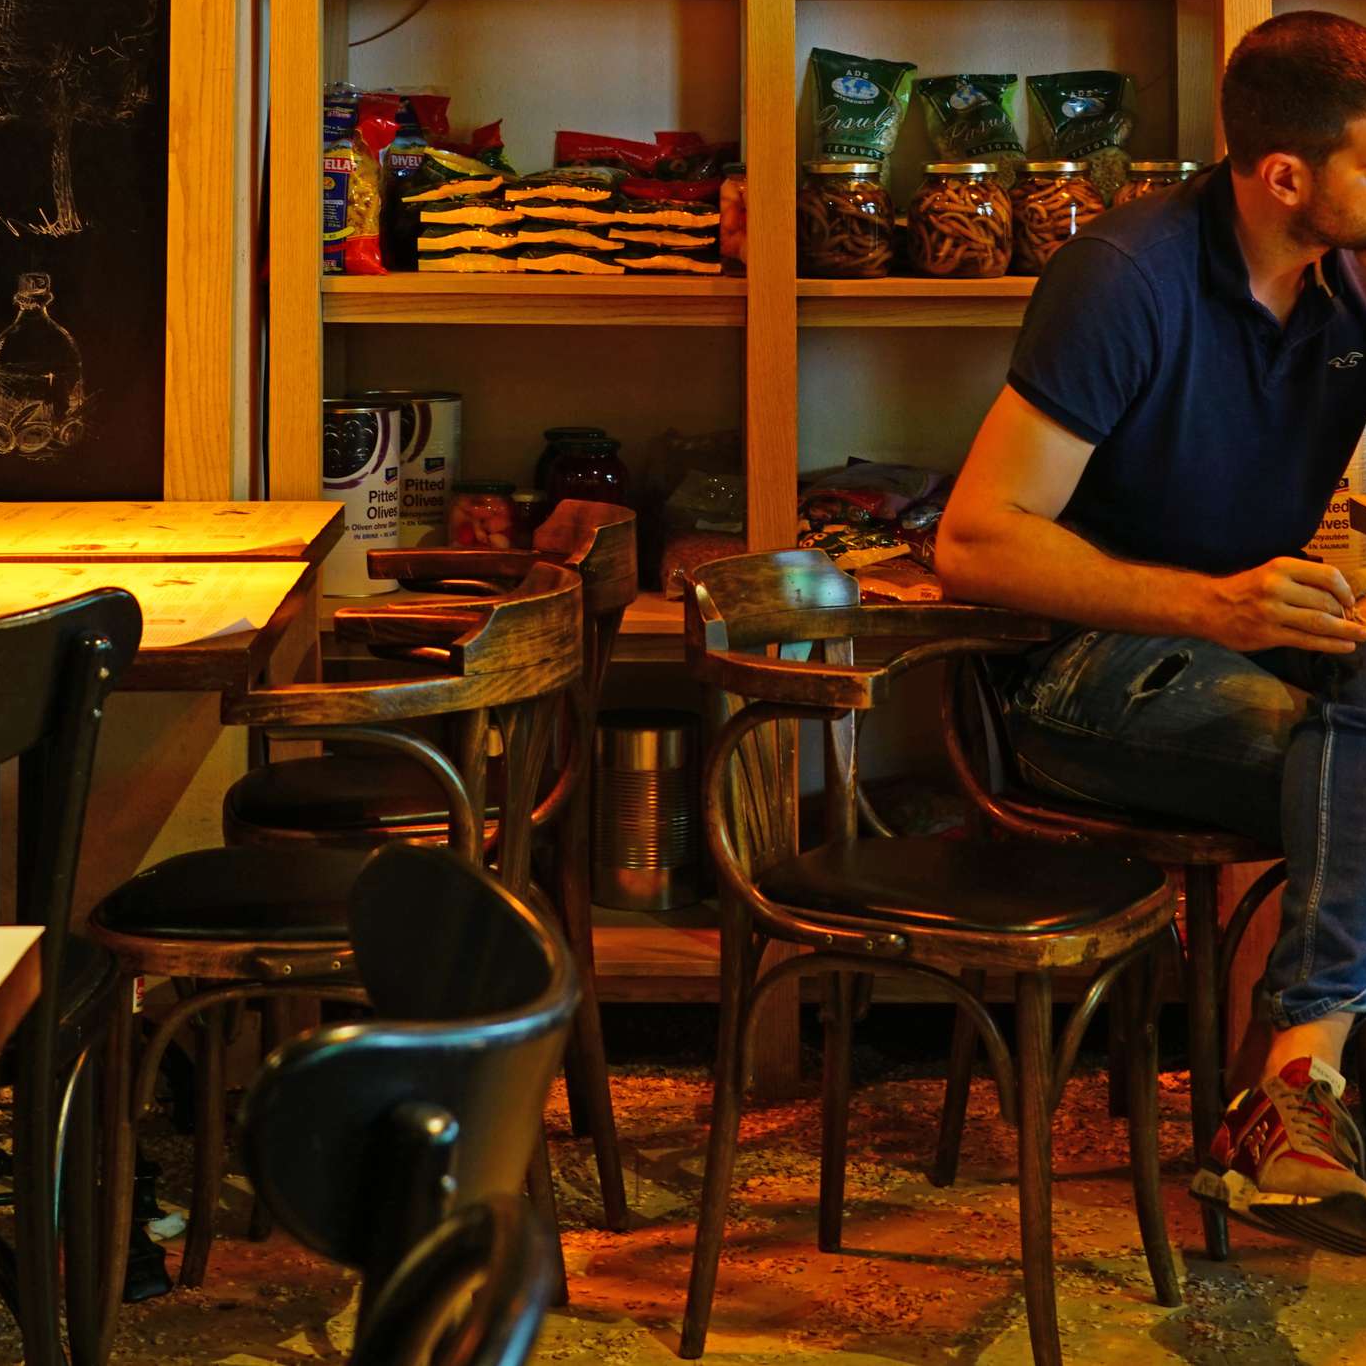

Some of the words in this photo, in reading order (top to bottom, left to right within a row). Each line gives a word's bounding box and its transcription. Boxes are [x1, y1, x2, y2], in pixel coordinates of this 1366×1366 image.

[846, 69, 870, 79] ADS
[817, 104, 896, 138] Pasulj
[323, 159, 352, 172] ELLA
[405, 478, 444, 491] Pitted
[403, 494, 444, 507] Olives
[367, 506, 398, 520] Olives
